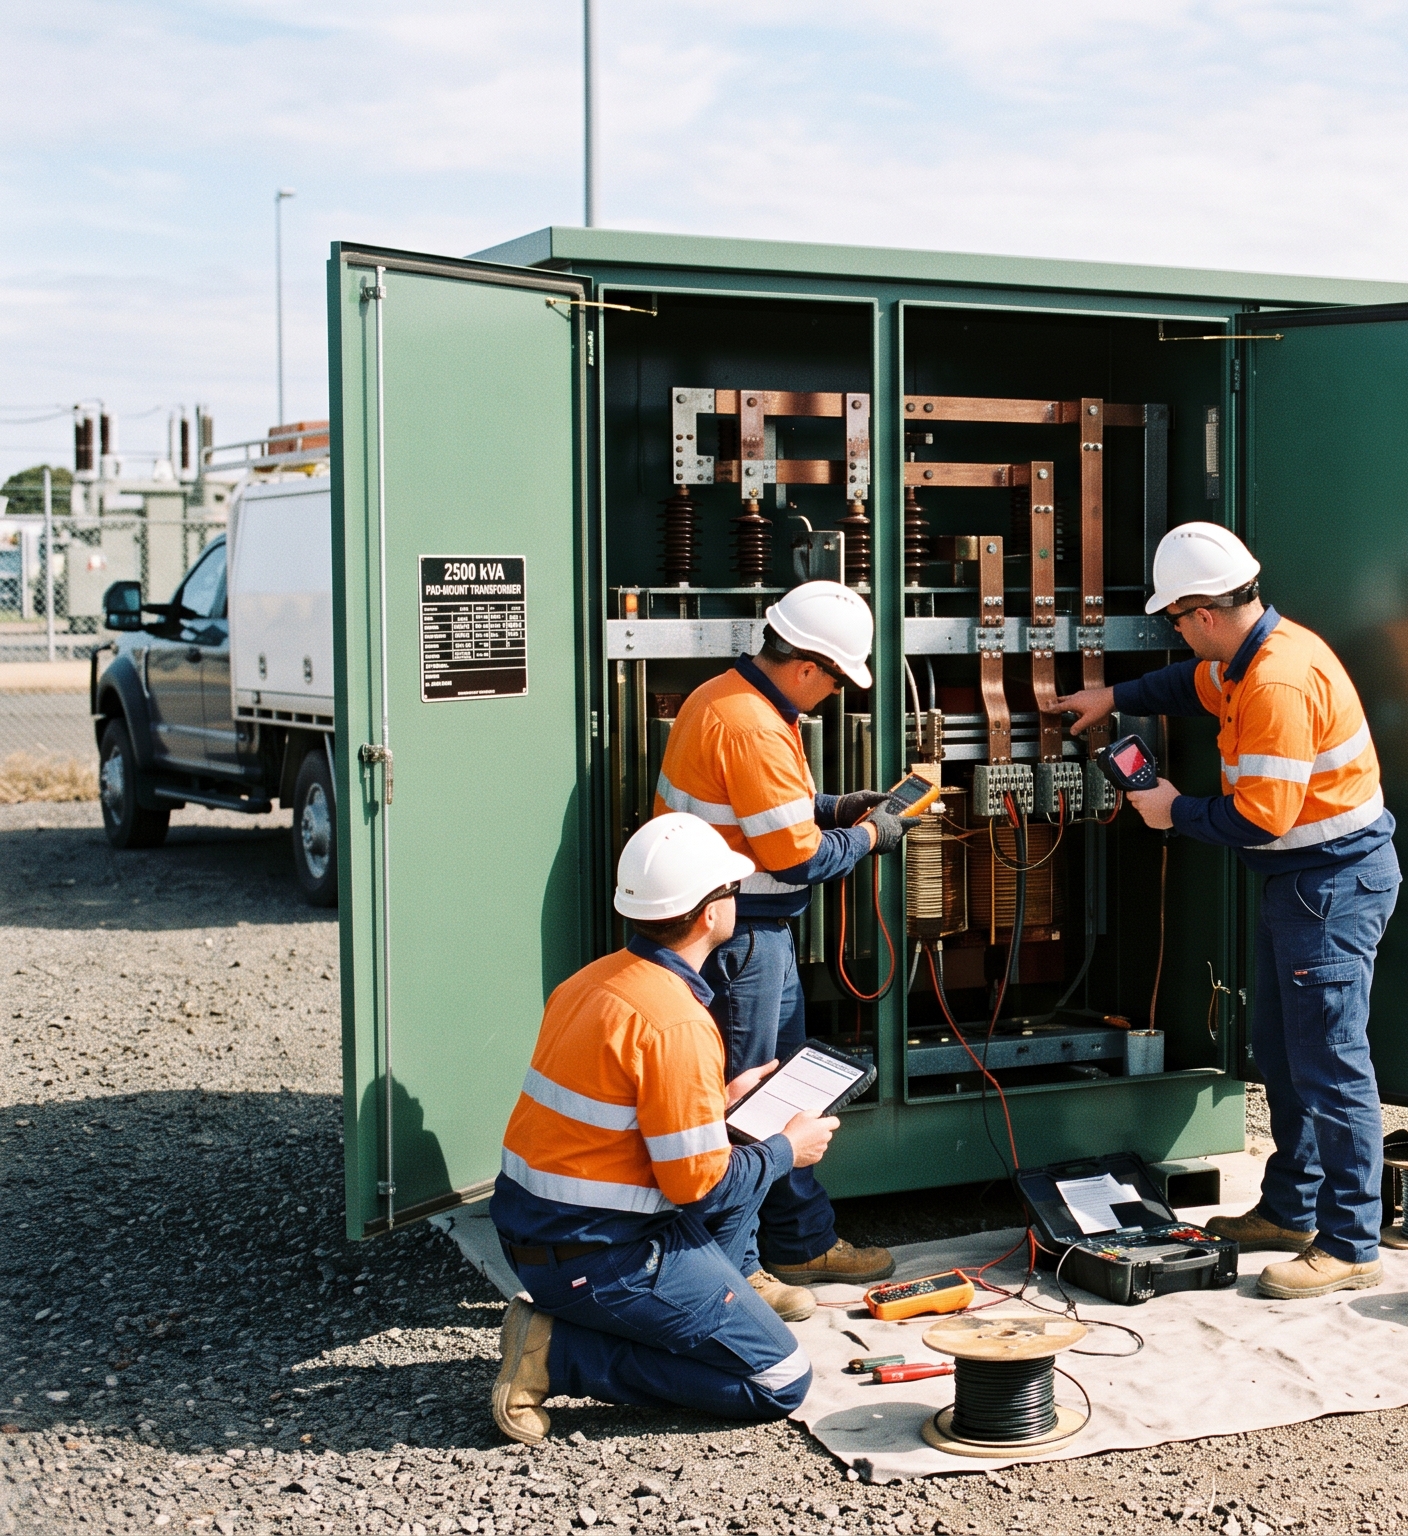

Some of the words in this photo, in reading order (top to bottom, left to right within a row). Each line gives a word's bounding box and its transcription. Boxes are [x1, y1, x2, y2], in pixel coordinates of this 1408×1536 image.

[444, 563, 476, 581] 2500
[479, 563, 505, 581] kVA
[425, 584, 469, 596] PAD-MOUNT
[470, 584, 522, 595] TRANSFORMER
